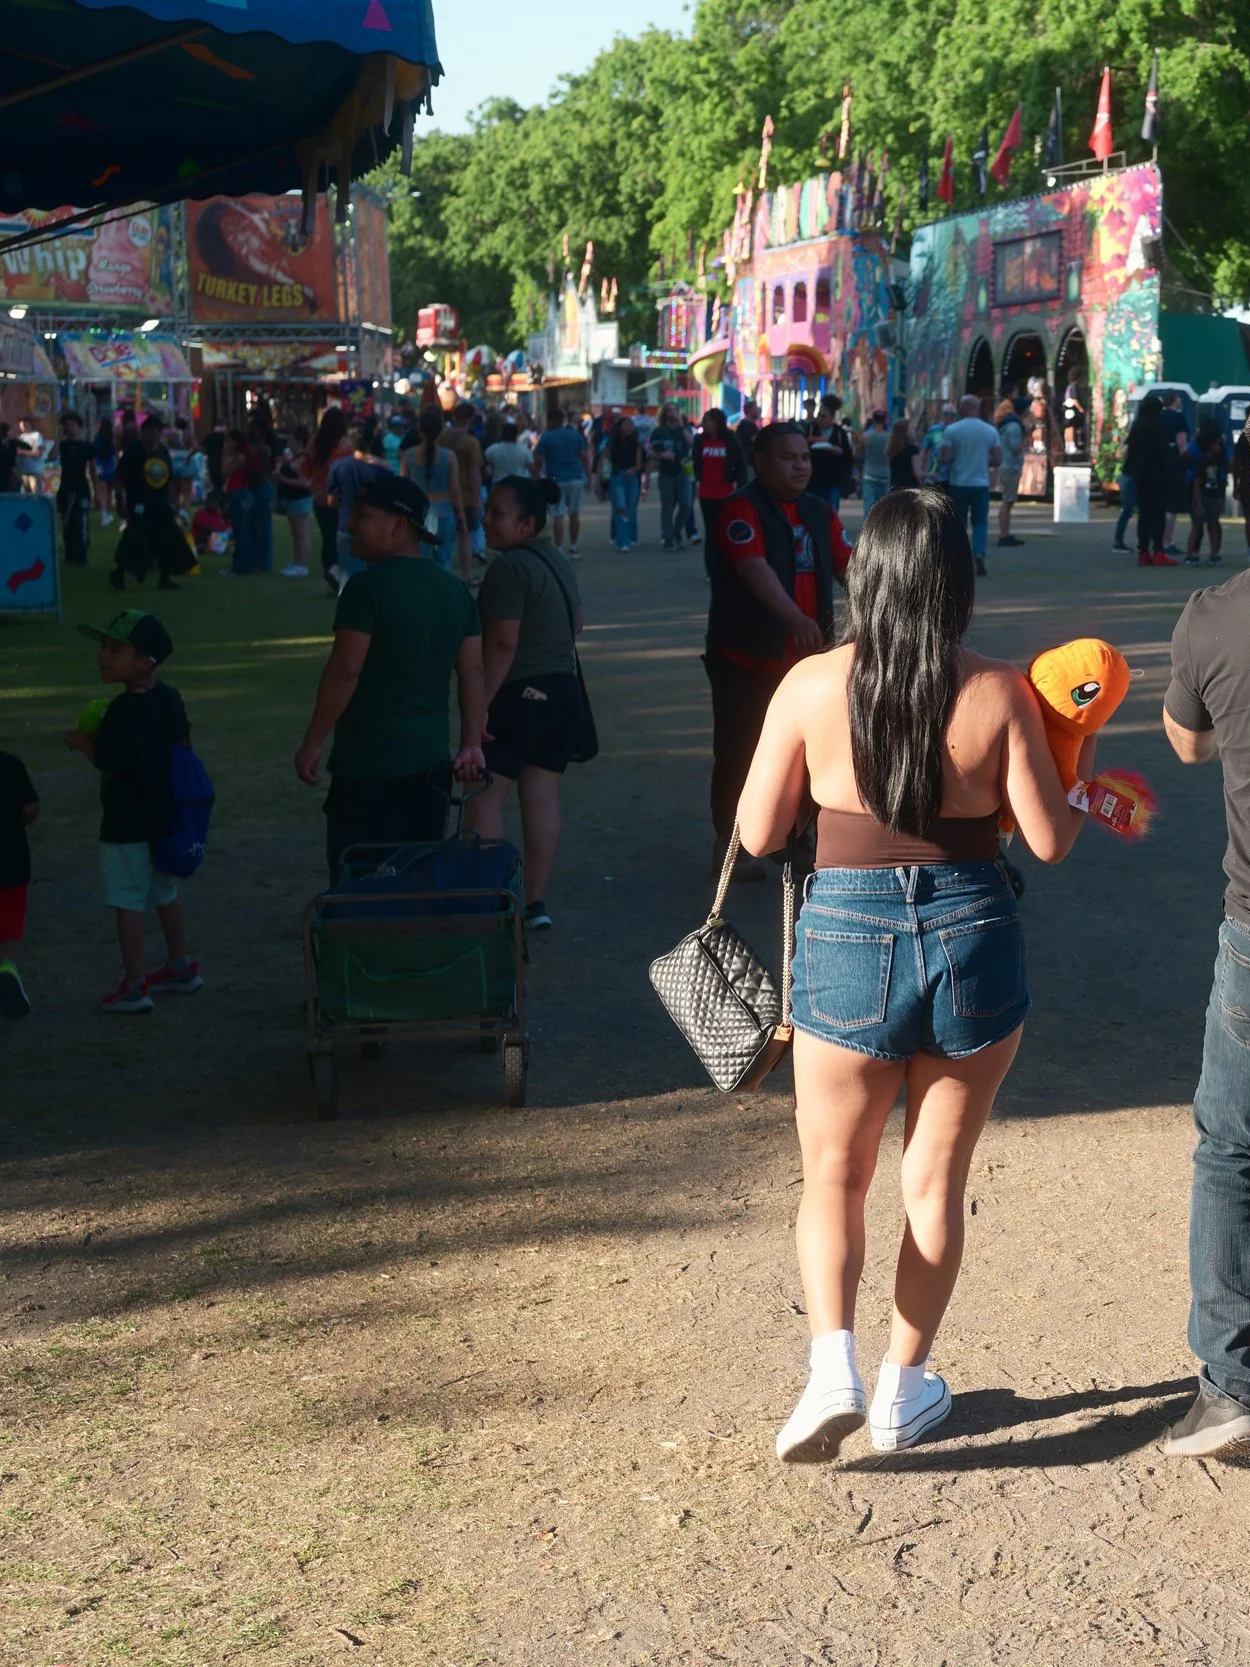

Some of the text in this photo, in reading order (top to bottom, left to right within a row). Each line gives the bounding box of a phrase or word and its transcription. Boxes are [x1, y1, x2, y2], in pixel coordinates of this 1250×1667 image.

[198, 272, 304, 308] TURKEY LEGS
[702, 447, 726, 457] PINK
